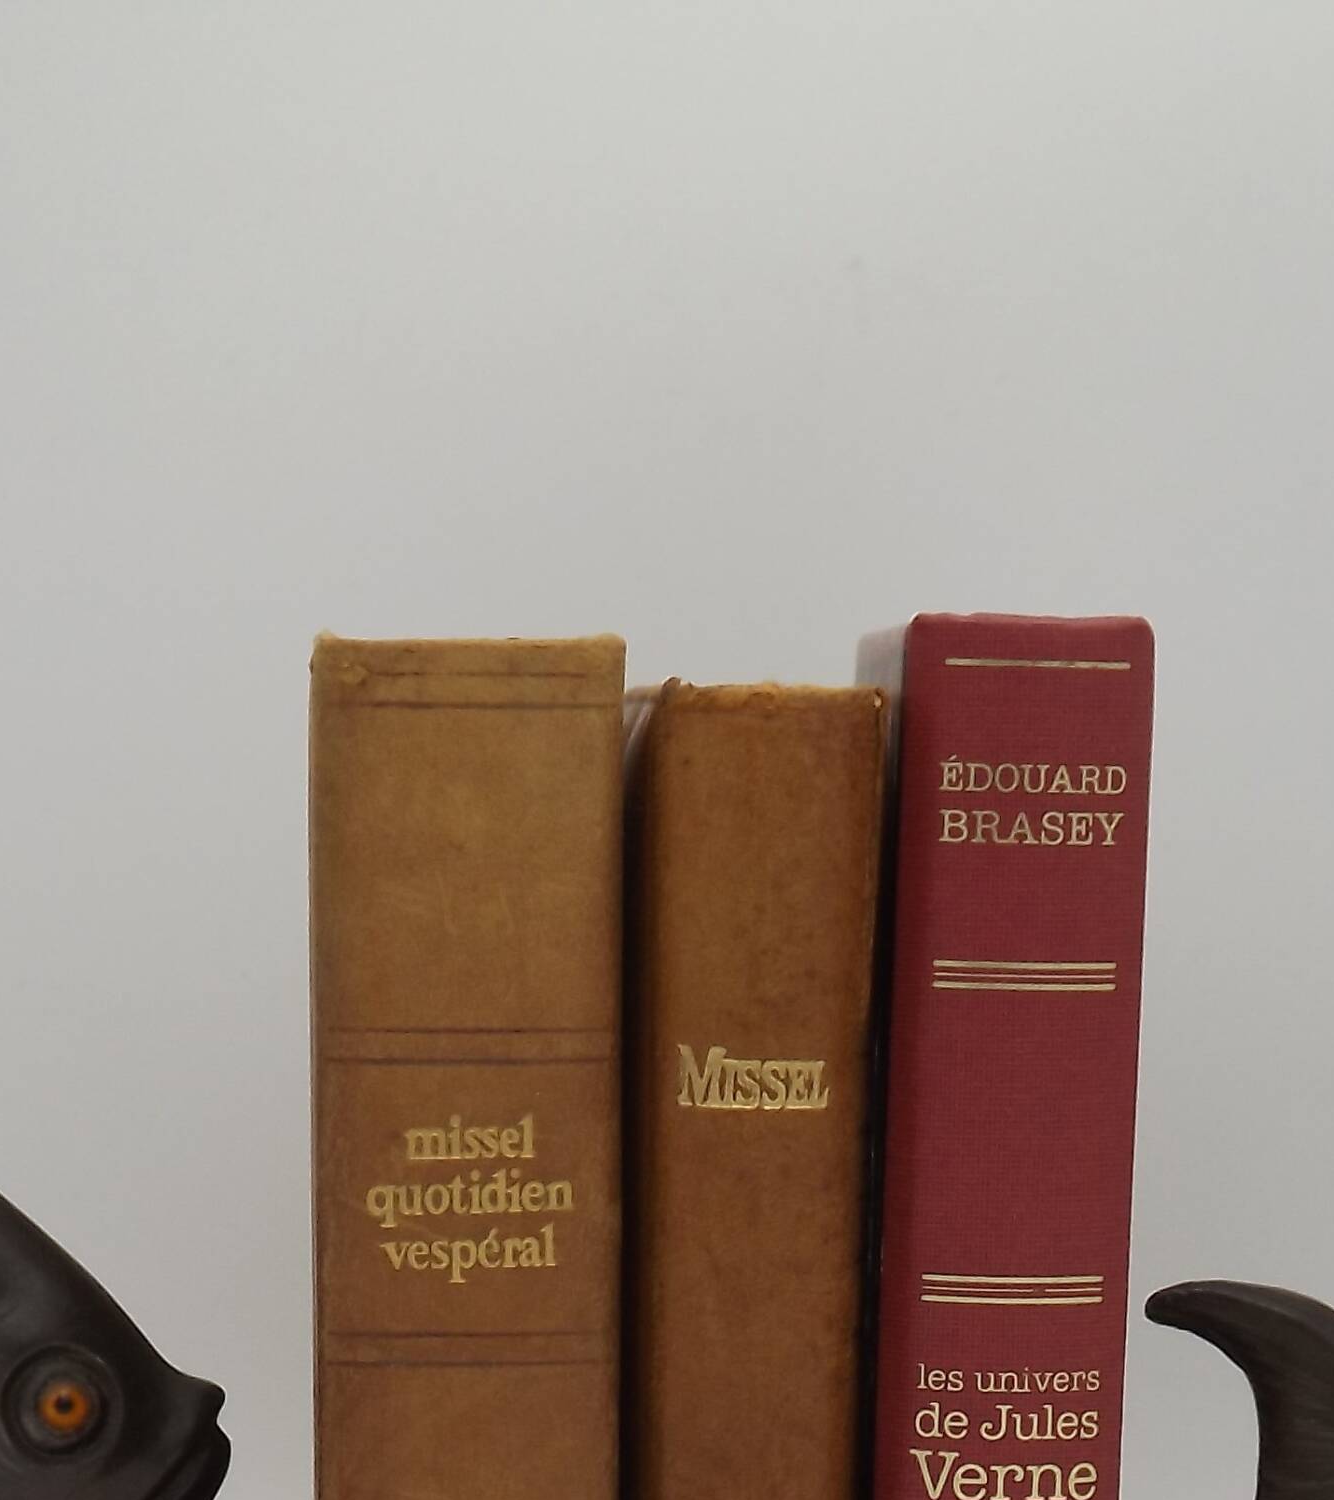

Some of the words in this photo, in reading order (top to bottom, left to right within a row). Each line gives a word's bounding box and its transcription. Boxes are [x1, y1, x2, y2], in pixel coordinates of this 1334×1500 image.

[939, 754, 1127, 795] ÉDOUARD
[938, 809, 1125, 846] BRASEY
[403, 1112, 535, 1160] missel
[366, 1168, 574, 1228] quotidien
[379, 1222, 557, 1283] vespéral
[917, 1363, 964, 1391] les
[974, 1367, 1100, 1393] univers
[915, 1402, 968, 1440] de
[979, 1404, 1099, 1441] Jules
